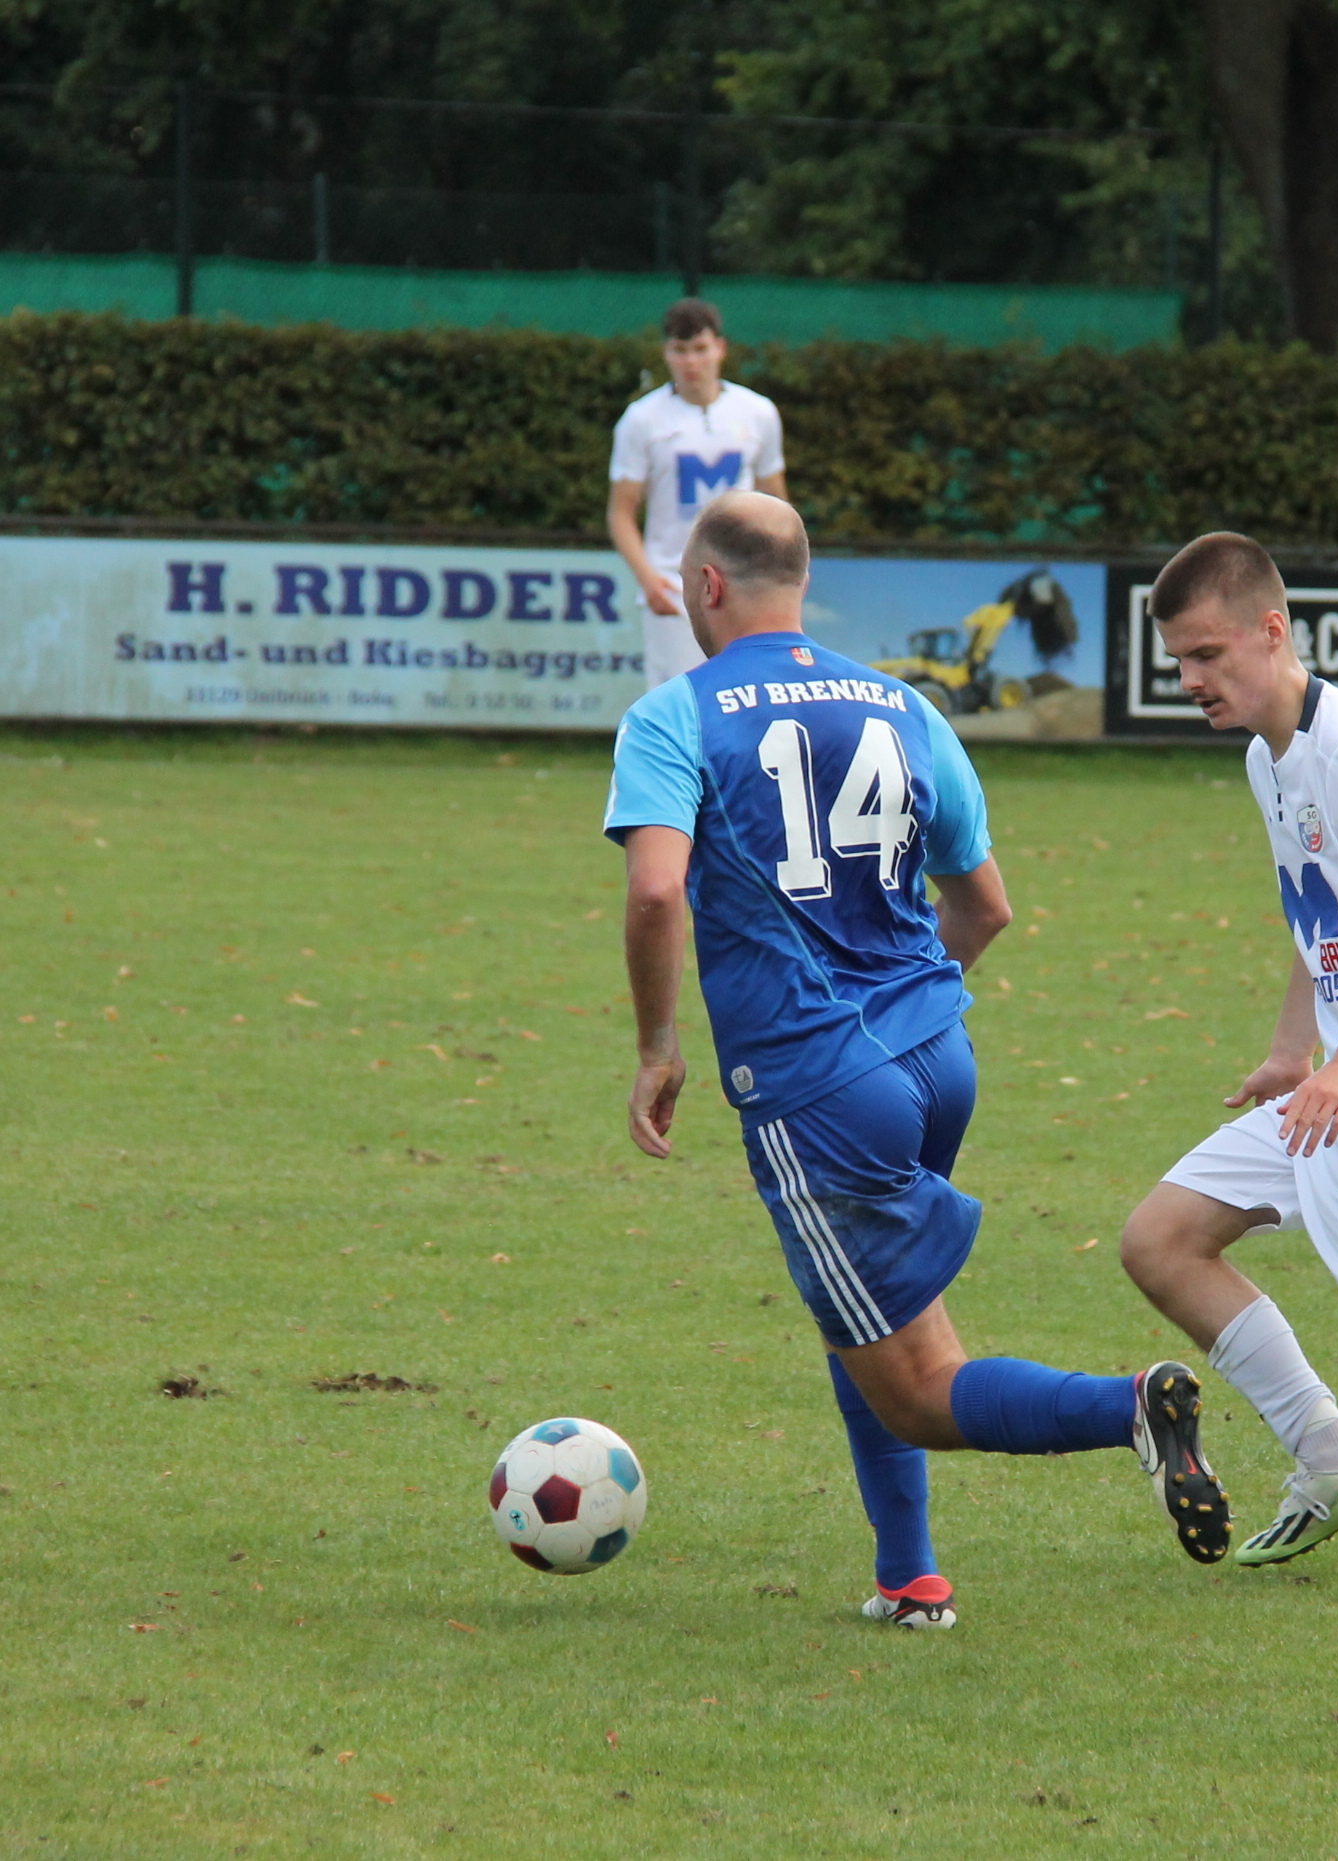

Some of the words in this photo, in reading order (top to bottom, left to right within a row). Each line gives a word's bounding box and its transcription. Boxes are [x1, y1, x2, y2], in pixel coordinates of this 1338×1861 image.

[166, 561, 253, 615] H.
[274, 563, 620, 623] RIDDER
[115, 633, 247, 664] Sand-
[260, 639, 349, 667] und
[716, 684, 757, 714] SV
[763, 678, 908, 713] BRENKEN
[757, 716, 919, 902] 14
[1306, 810, 1318, 821] SG
